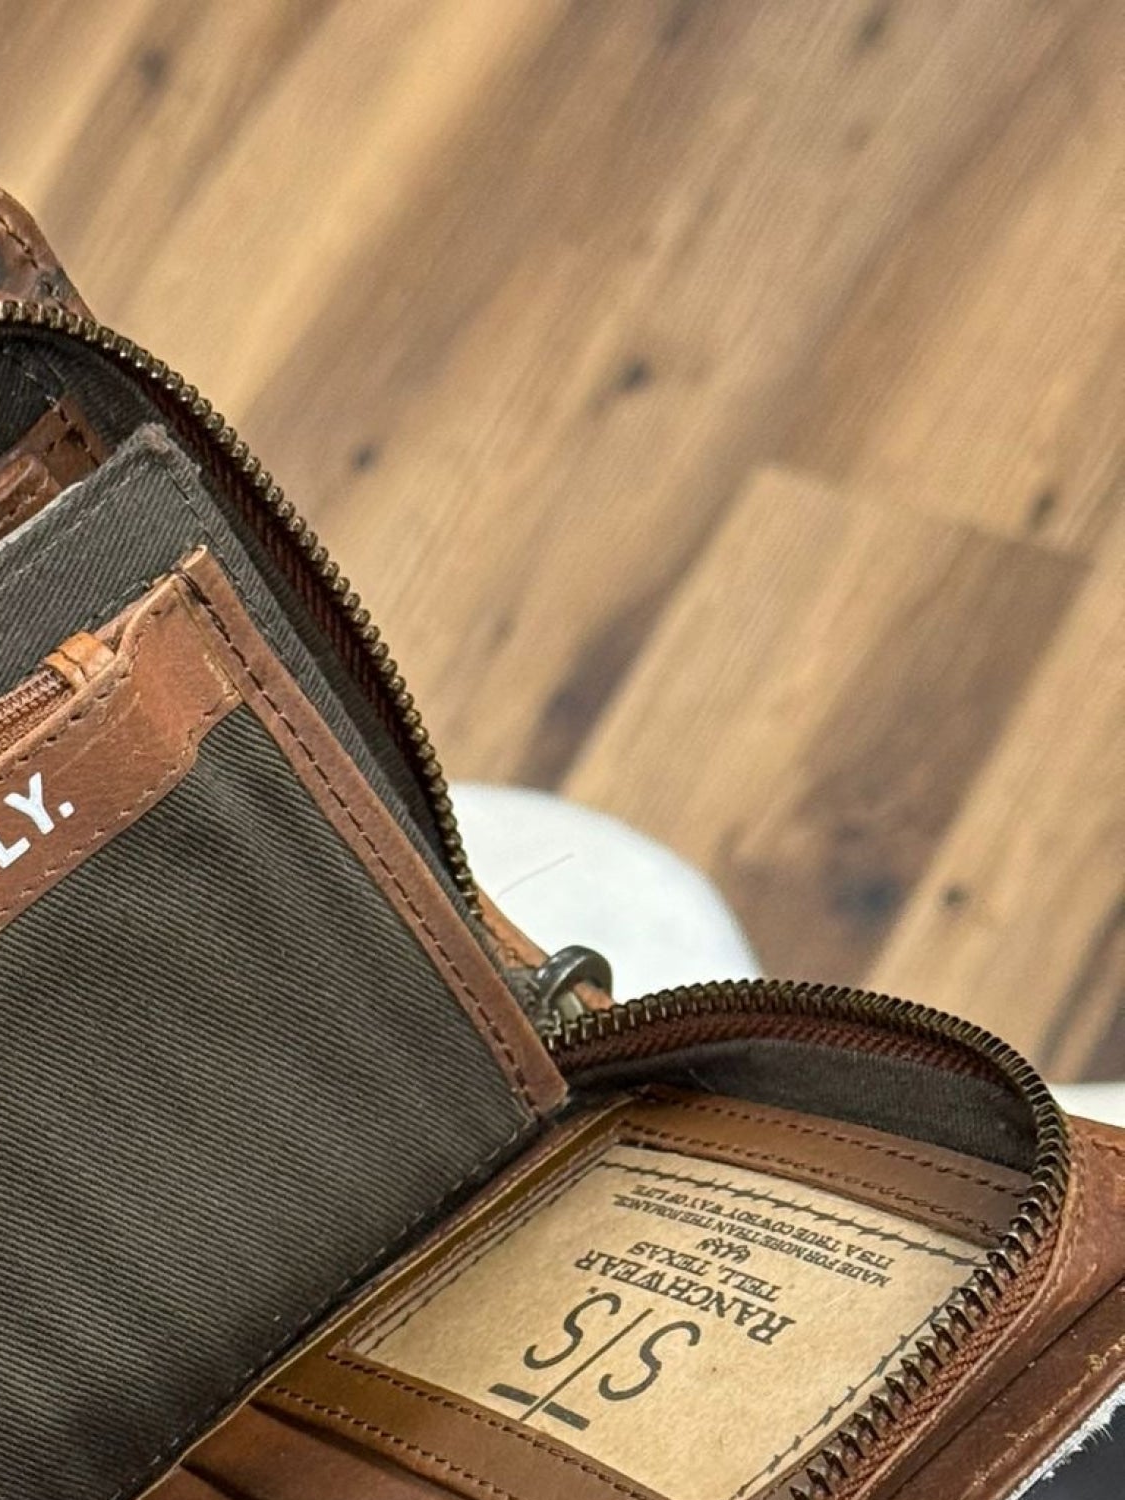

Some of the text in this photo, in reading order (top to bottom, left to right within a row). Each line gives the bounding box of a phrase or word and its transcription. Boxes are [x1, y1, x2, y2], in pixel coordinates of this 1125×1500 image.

[711, 1219, 762, 1243] THAN
[723, 1207, 795, 1236] COWBOY
[758, 1235, 806, 1258] MORE
[791, 1227, 842, 1253] TRUE
[845, 1244, 863, 1257] A
[627, 1241, 782, 1302] TELL, TEXAS
[803, 1250, 841, 1270] FOR
[835, 1262, 892, 1287] MADE
[574, 1250, 796, 1345] RANCHWEAR
